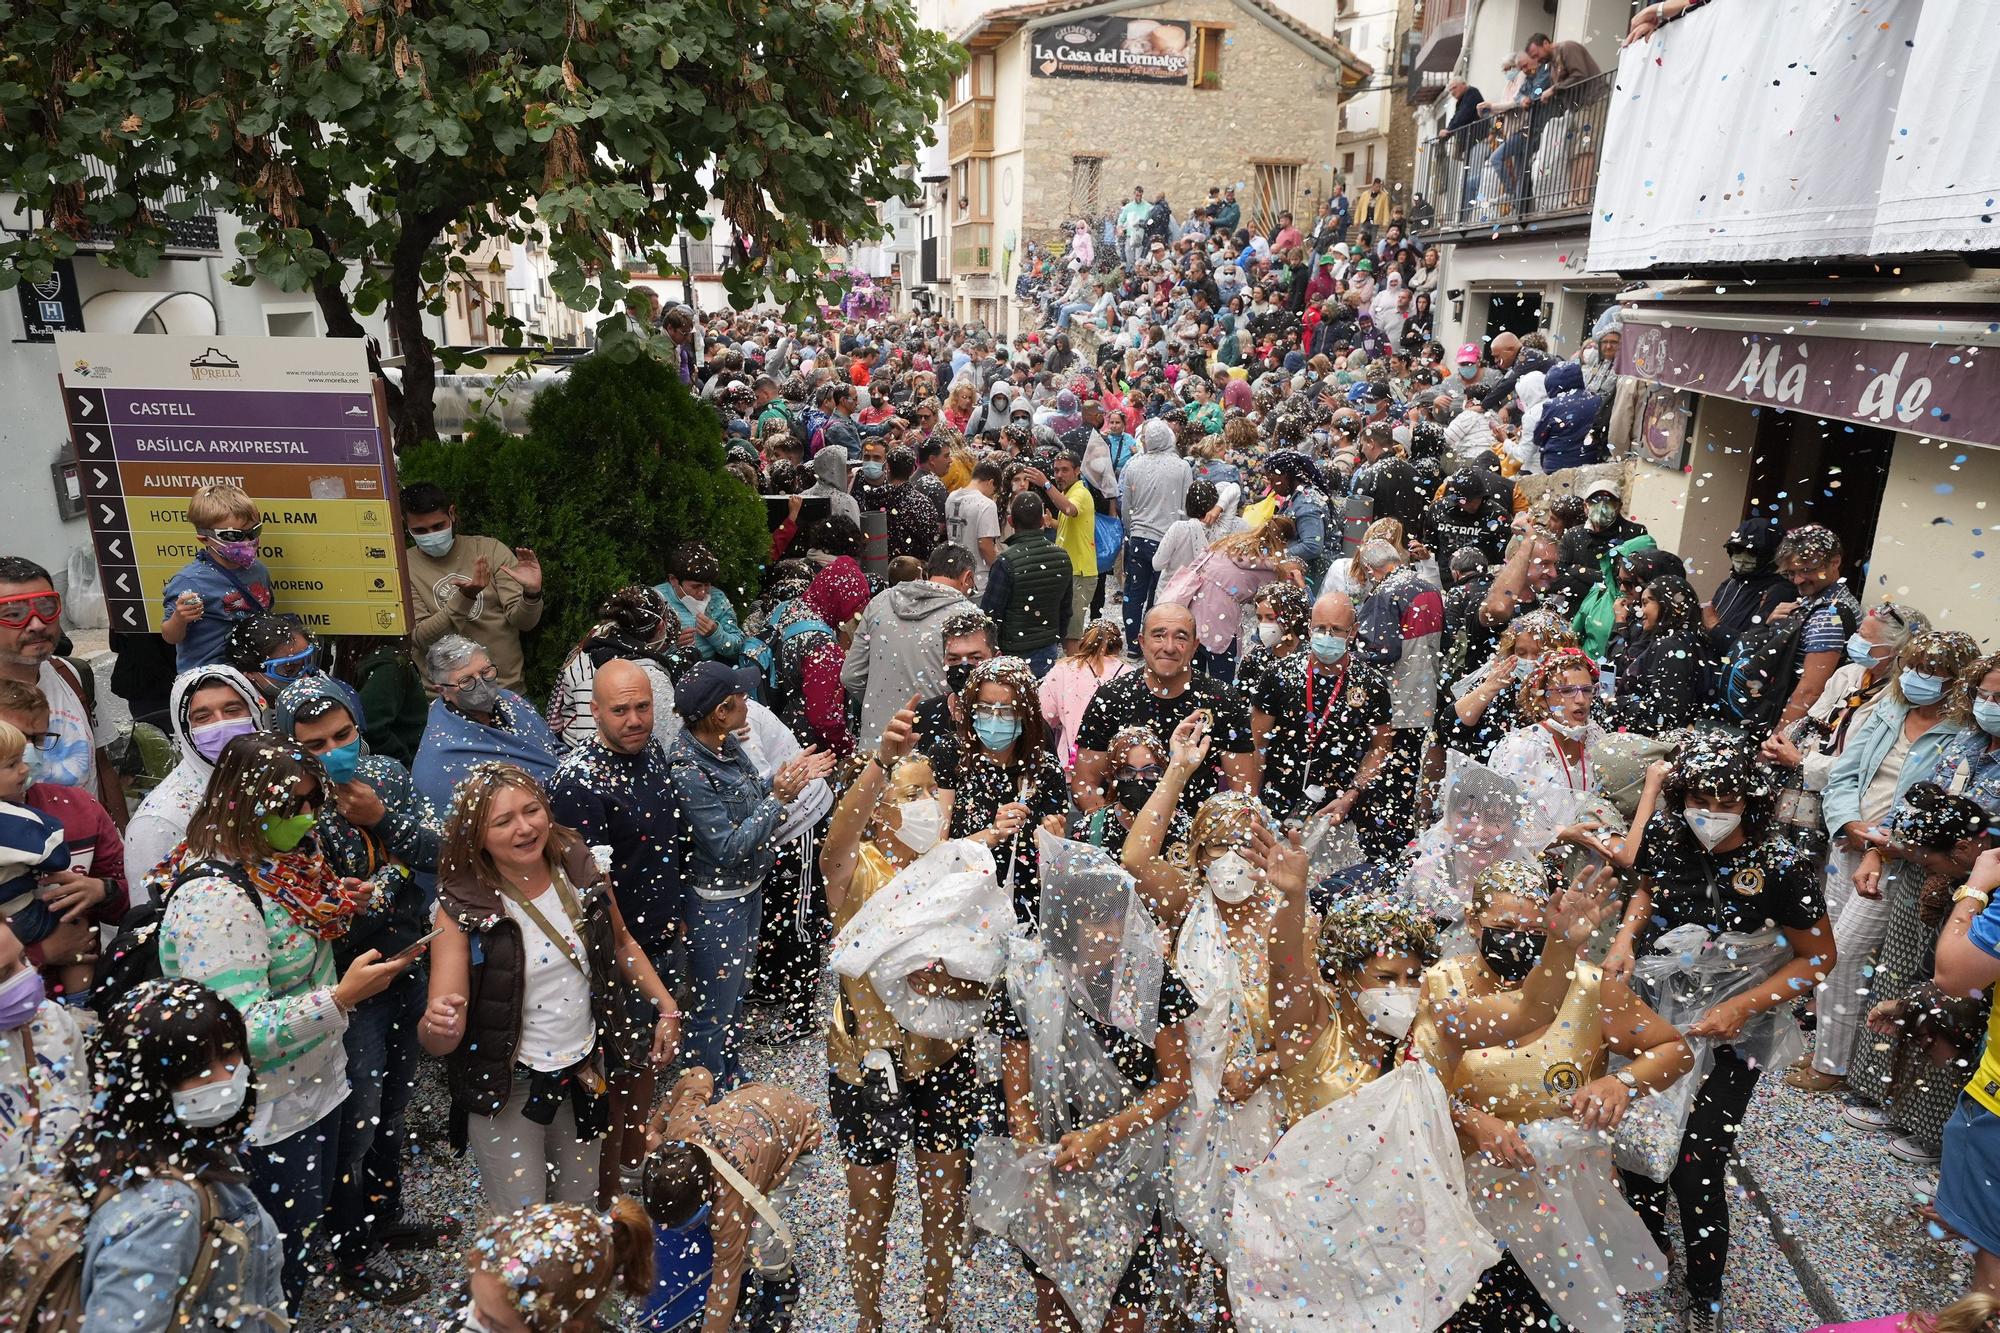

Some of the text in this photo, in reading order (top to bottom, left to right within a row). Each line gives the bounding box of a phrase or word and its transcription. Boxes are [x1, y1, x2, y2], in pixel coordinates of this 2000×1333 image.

[1034, 44, 1187, 72] La Casa del Formatge
[190, 367, 241, 381] MORELLA
[1725, 342, 1933, 423] Mà de
[129, 402, 196, 416] CASTELL
[136, 437, 309, 454] BASÍLICA ARXIPRESTAL
[143, 474, 245, 488] AJUNTAMENT
[150, 510, 189, 523] HOTE
[283, 512, 318, 524] RAM
[270, 580, 324, 590] MORENO
